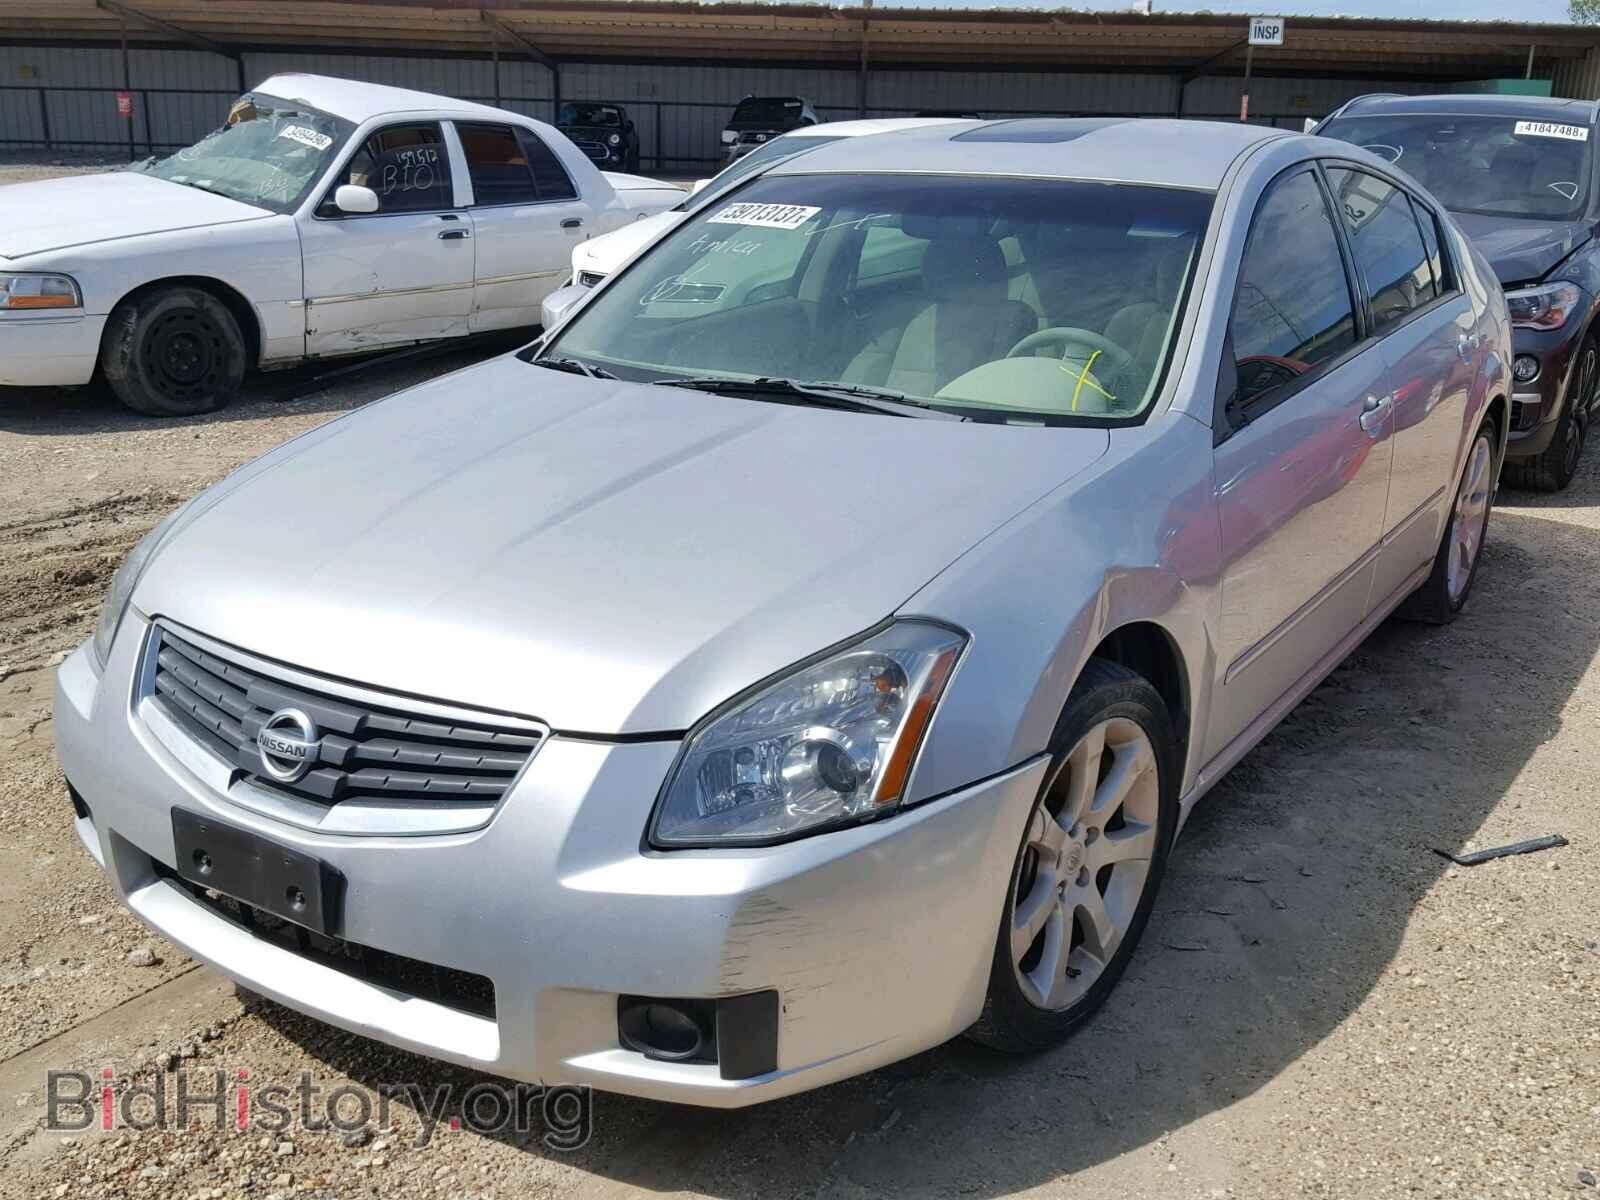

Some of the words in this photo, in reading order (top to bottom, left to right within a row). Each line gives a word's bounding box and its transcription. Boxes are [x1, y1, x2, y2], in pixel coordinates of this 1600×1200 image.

[1253, 25, 1280, 40] INSP
[1525, 123, 1580, 137] 41847488
[722, 204, 807, 223] 39713137
[259, 734, 306, 757] NISSAN
